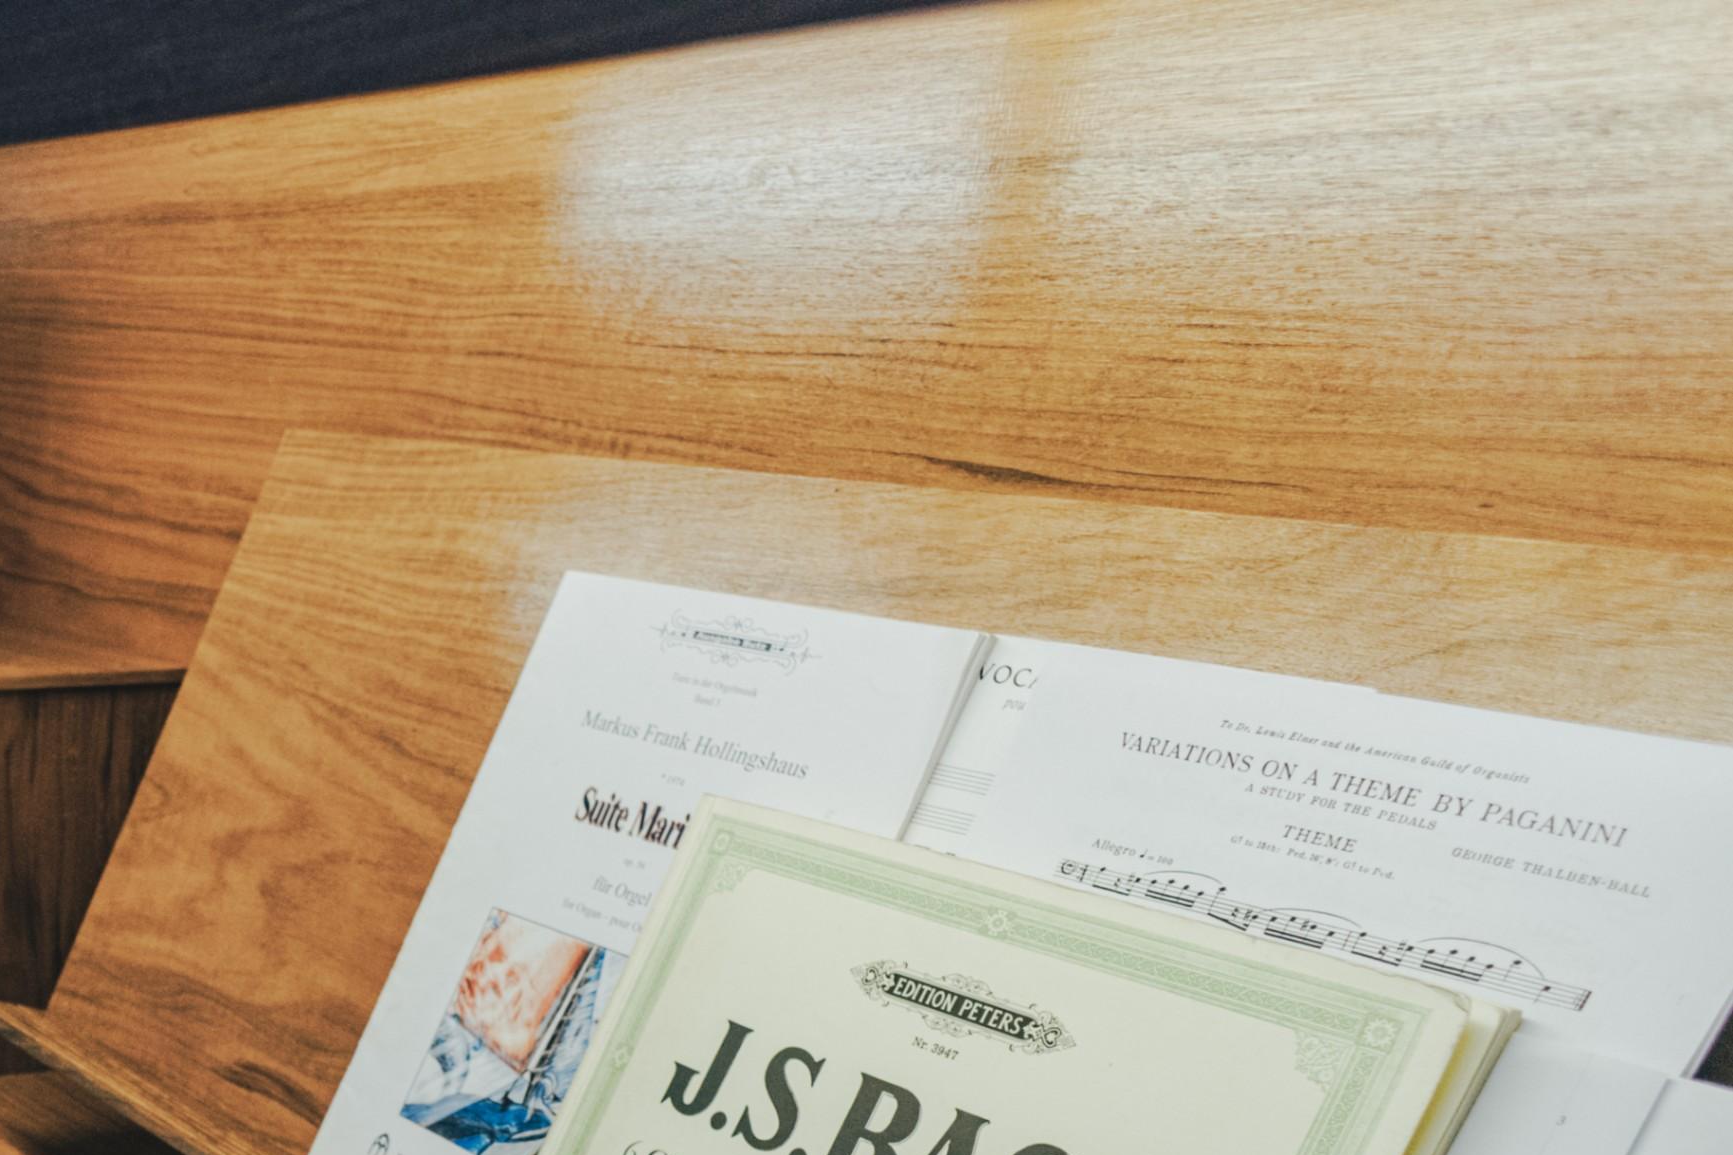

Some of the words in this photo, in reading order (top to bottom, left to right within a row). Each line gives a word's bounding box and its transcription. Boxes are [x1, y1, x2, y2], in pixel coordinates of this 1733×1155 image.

[580, 709, 641, 739] Markus
[642, 723, 692, 751] Frank
[693, 735, 810, 780] Hollingshaus
[1321, 739, 1342, 750] and
[1344, 742, 1361, 752] the
[1364, 747, 1418, 763] American
[1421, 756, 1454, 771] Guild
[1455, 763, 1472, 774] of
[1472, 765, 1531, 784] Organists
[1120, 732, 1254, 773] VARIATIONS
[1261, 759, 1299, 781] ON
[1302, 768, 1319, 786] A
[1330, 771, 1423, 808] THEME
[1431, 793, 1474, 817] BY
[1479, 802, 1628, 848] PAGANINI
[1244, 783, 1254, 793] A
[1259, 785, 1305, 803] STUDY
[1310, 795, 1338, 810] FOR
[1344, 801, 1372, 817] THE
[1377, 809, 1438, 831] PEDALS
[574, 786, 629, 833] Suite
[628, 801, 691, 850] Mari
[1282, 824, 1357, 853] THEME
[1091, 838, 1137, 856] Allegro
[592, 875, 613, 894] für
[615, 883, 653, 906] Orgel
[1451, 847, 1516, 870] GEORGE
[1522, 861, 1651, 899] THALBEN-BALL
[893, 977, 958, 1013] EDITION
[958, 999, 1024, 1034] PETERS
[912, 1036, 928, 1051] Nr.
[931, 1043, 959, 1060] 3947
